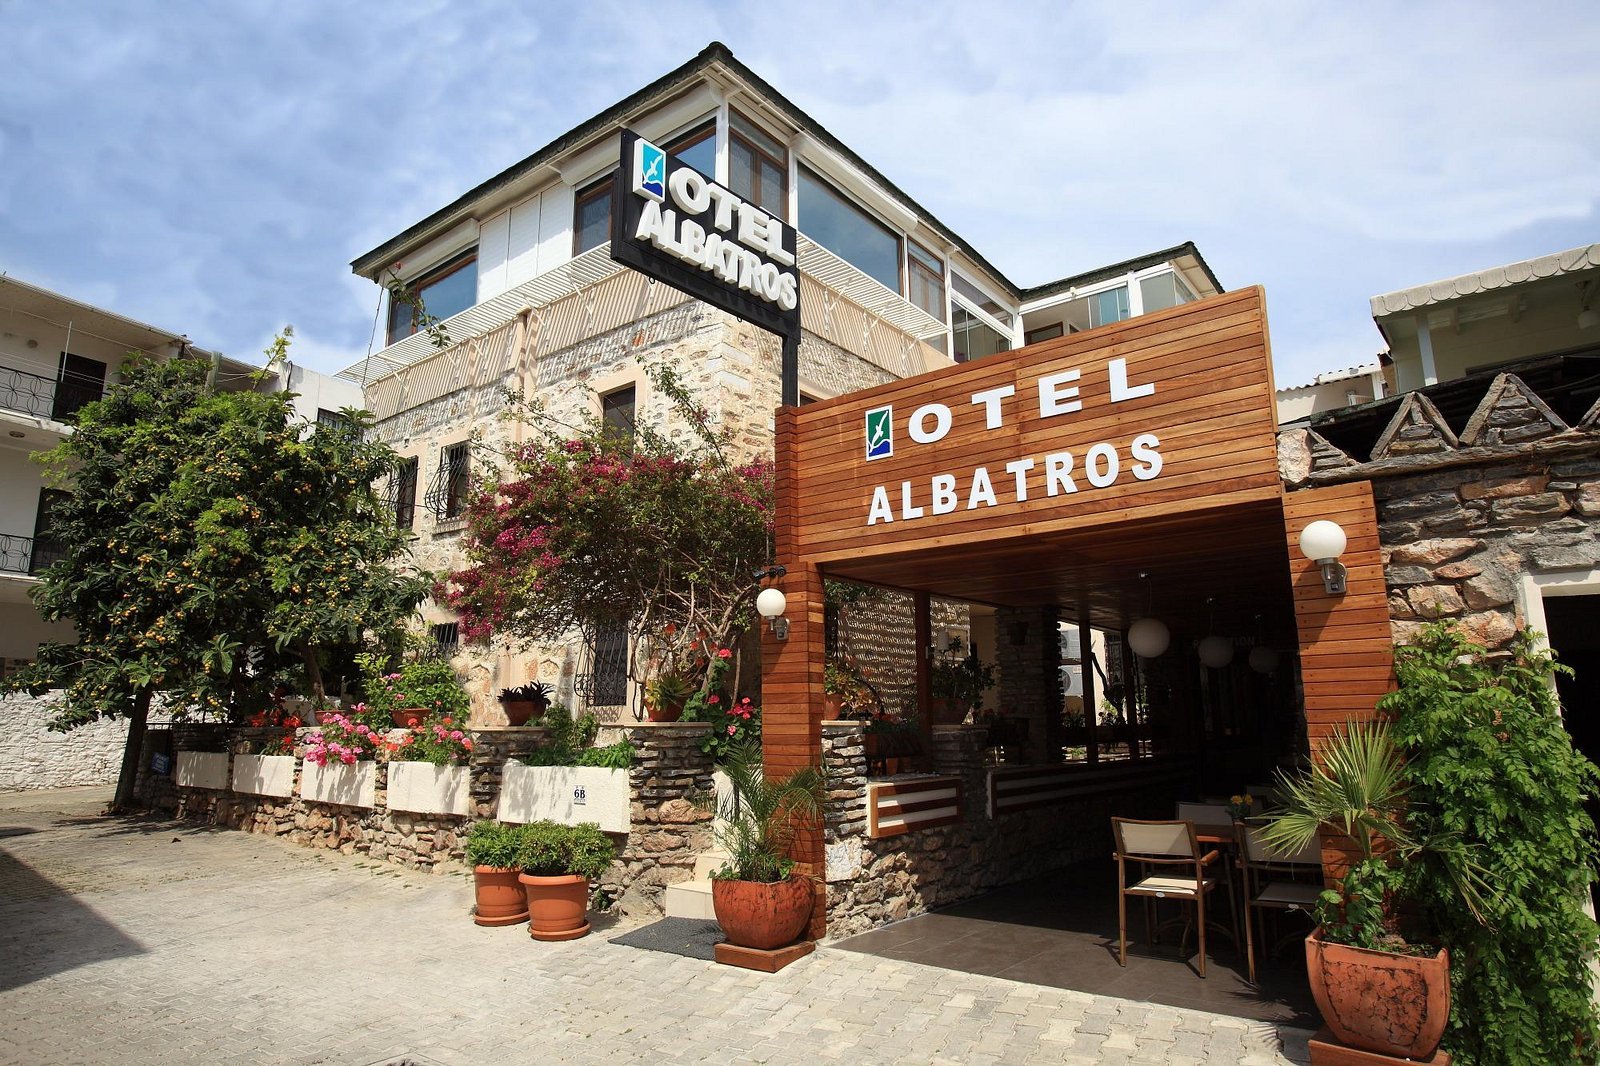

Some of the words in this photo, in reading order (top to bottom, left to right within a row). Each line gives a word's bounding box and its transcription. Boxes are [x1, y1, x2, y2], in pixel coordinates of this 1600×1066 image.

[635, 200, 797, 311] ALBATROS
[669, 167, 795, 267] OTEL
[908, 358, 1155, 444] OTEL
[867, 434, 1163, 526] ALBATROS
[574, 789, 585, 798] 6B
